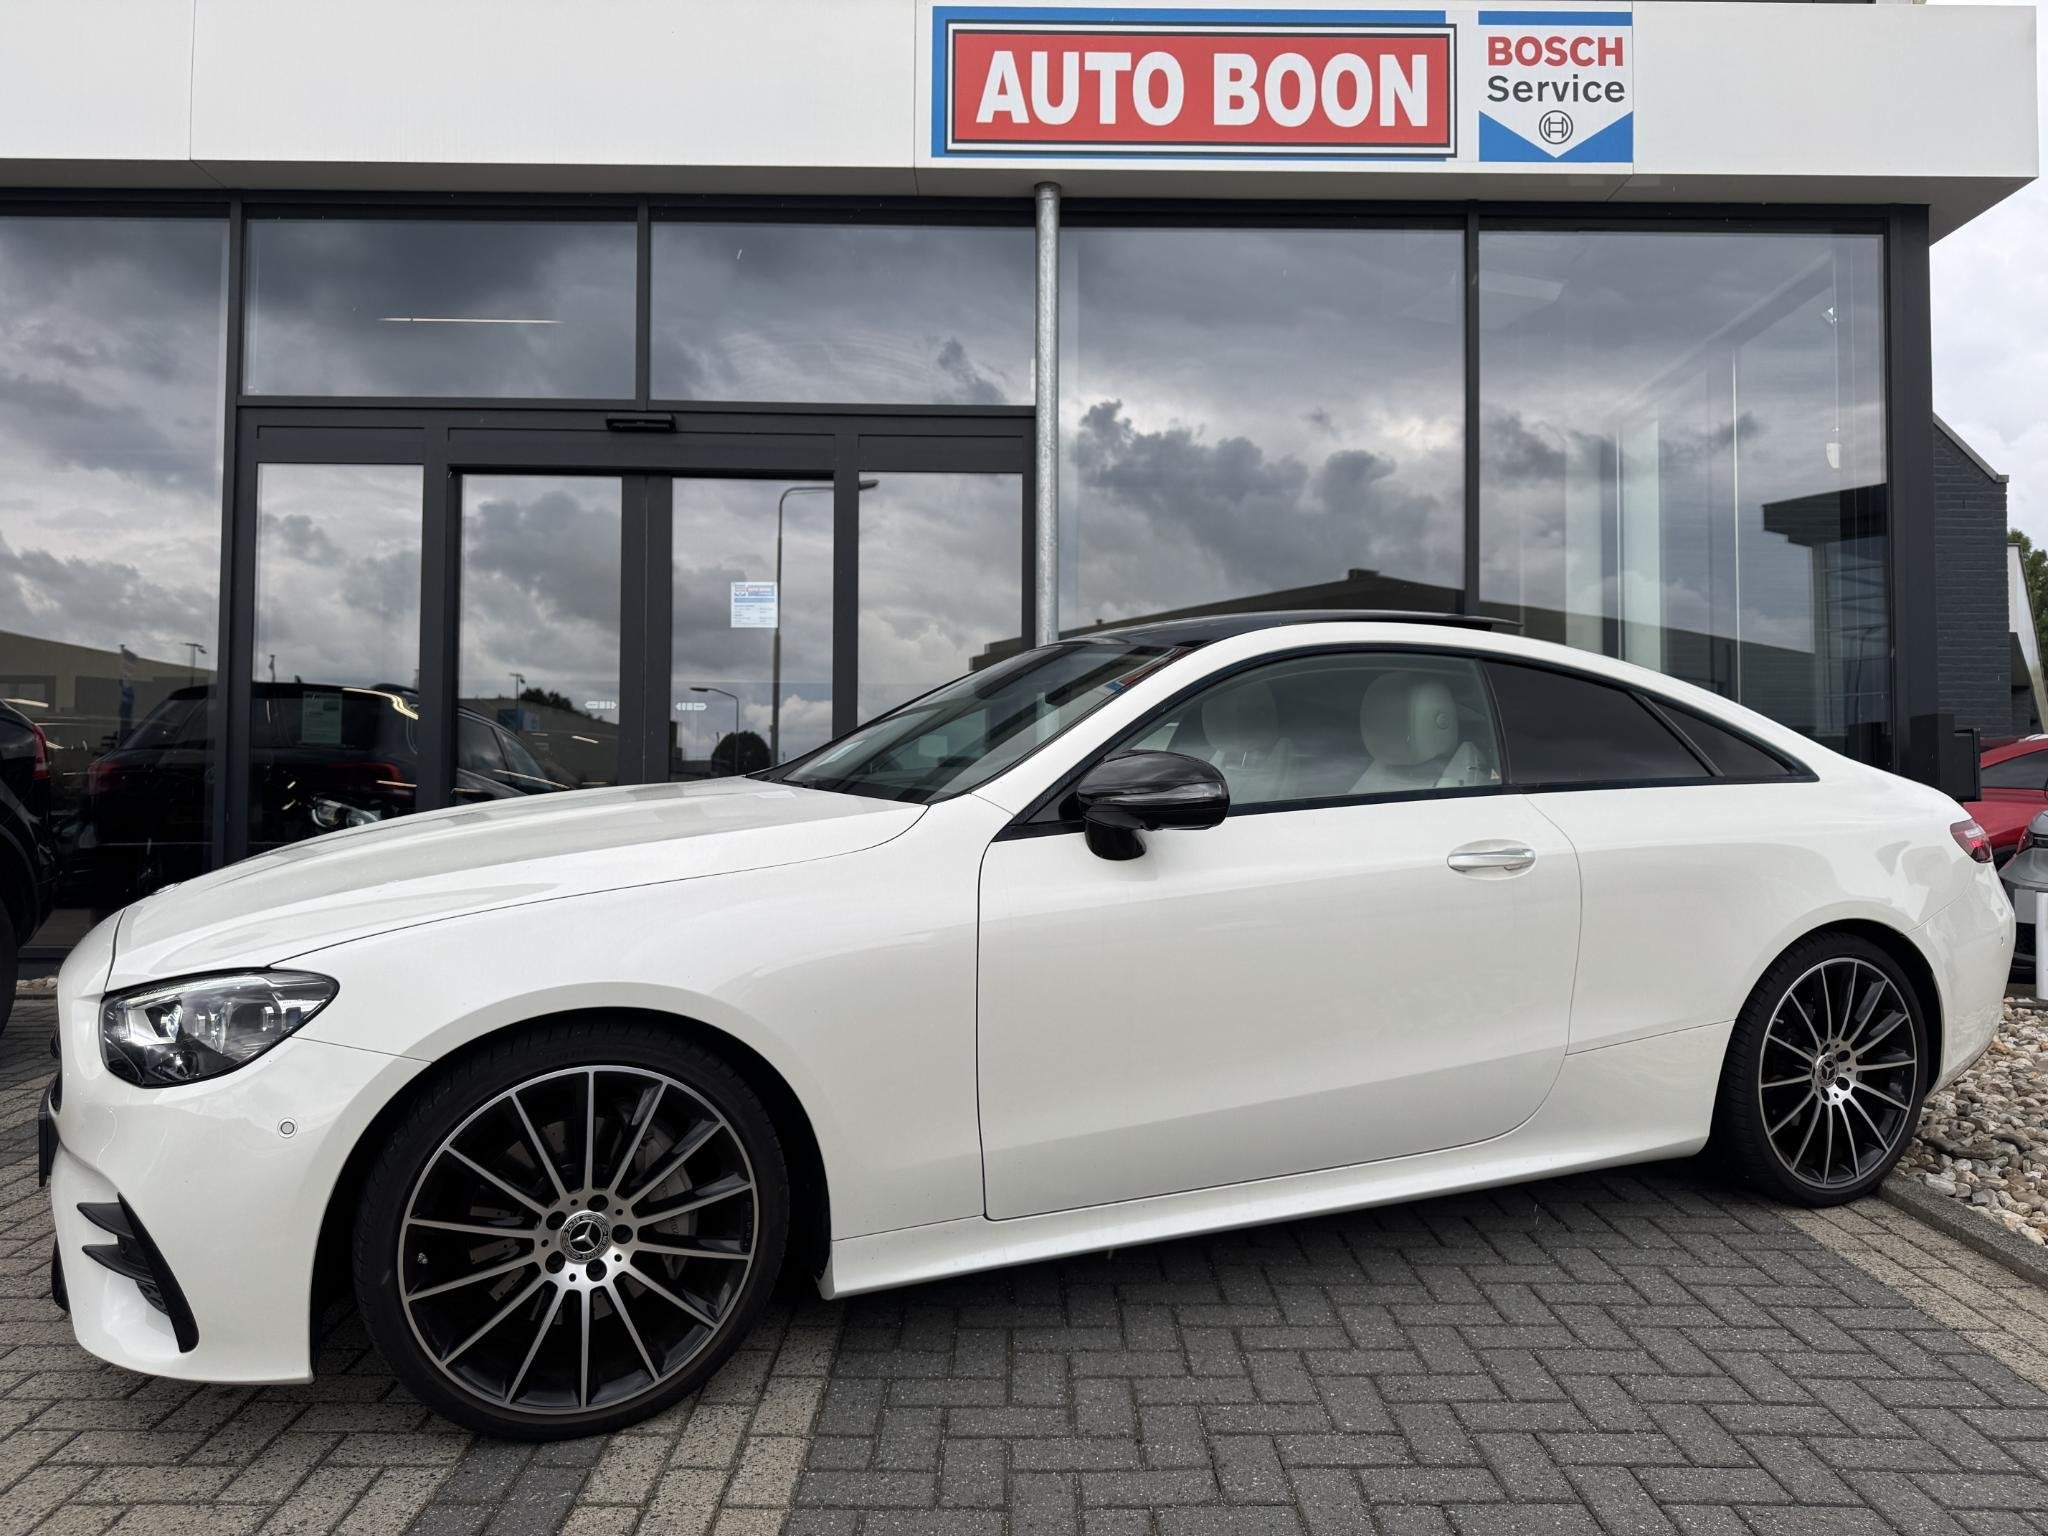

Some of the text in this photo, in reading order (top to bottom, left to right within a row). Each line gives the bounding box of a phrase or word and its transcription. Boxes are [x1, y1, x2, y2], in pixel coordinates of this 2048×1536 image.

[1487, 36, 1624, 67] BOSCH
[976, 50, 1428, 128] AUTO BOON
[1487, 73, 1625, 103] Service
